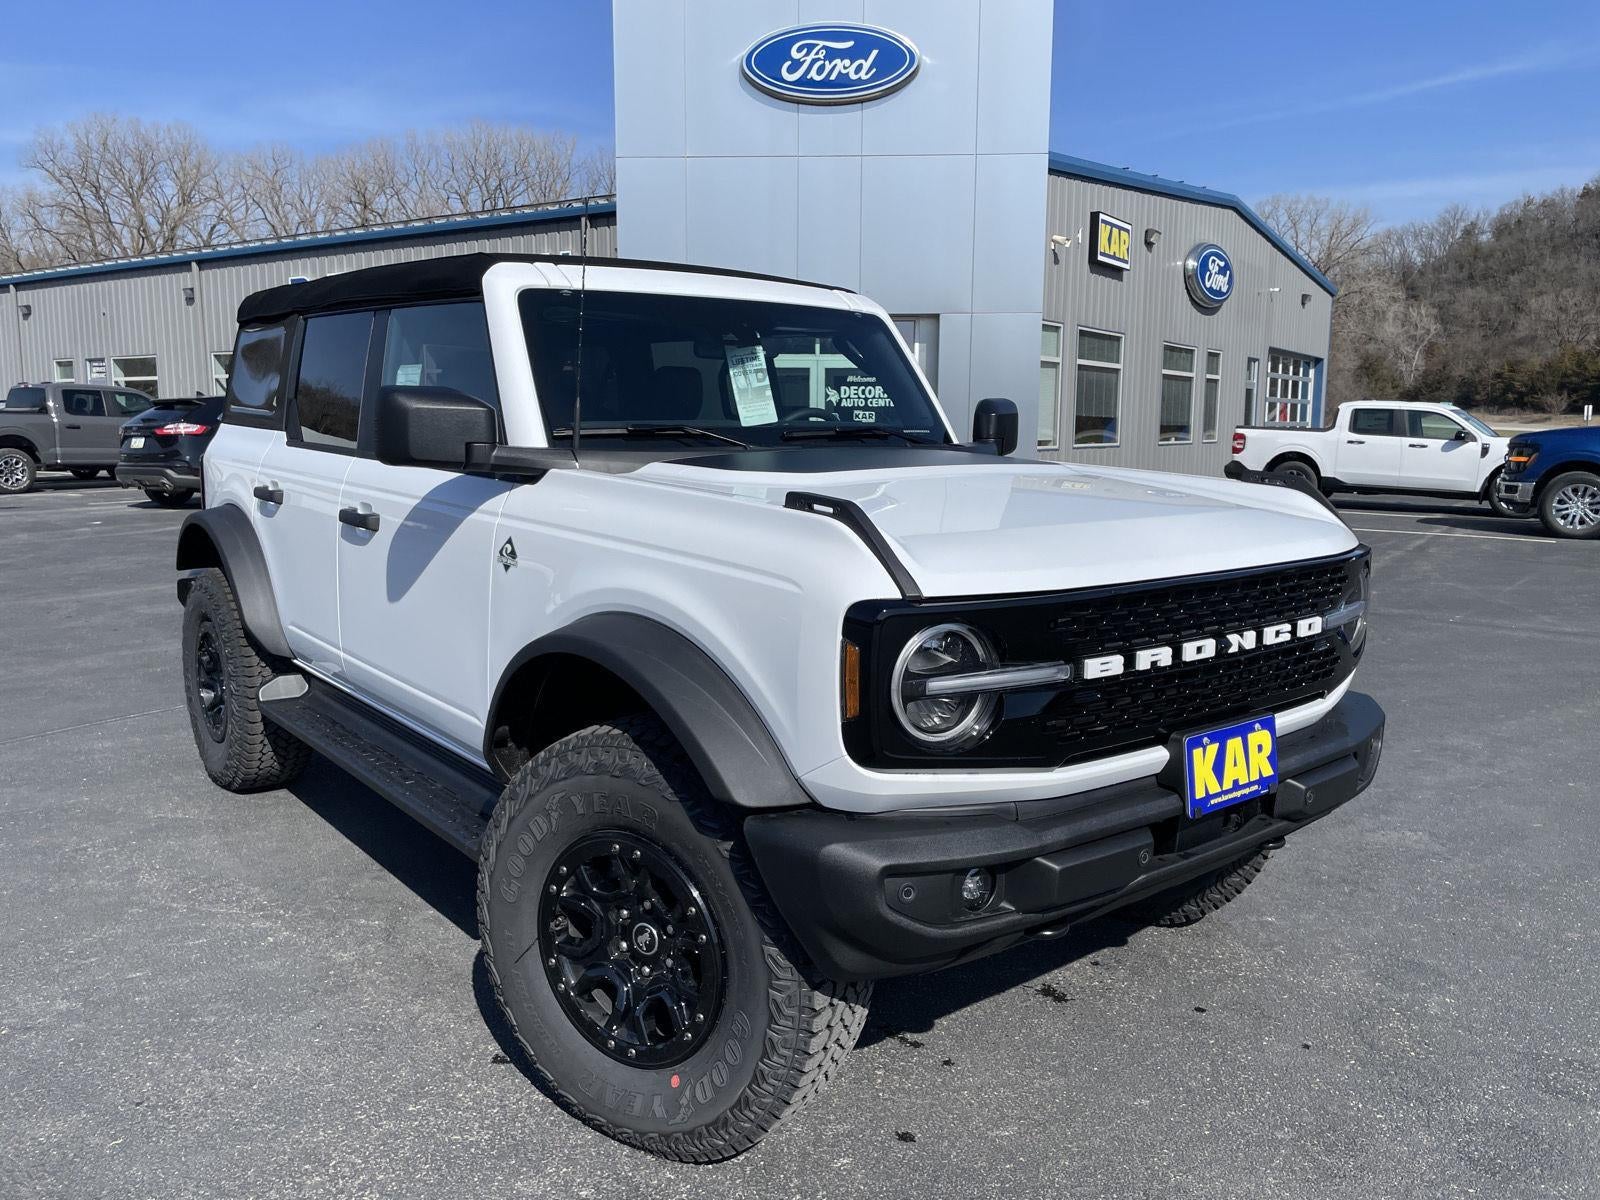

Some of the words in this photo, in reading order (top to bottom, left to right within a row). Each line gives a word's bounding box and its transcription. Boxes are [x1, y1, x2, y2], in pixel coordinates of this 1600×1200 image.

[781, 39, 880, 82] Ford
[1101, 223, 1130, 261] KAR
[1205, 255, 1230, 293] Ford
[731, 355, 762, 366] LIFETIME
[847, 375, 877, 383] Welcome
[840, 398, 865, 407] AUTO
[854, 412, 875, 420] KAR
[1083, 616, 1323, 680] BRONCO
[1192, 729, 1275, 800] KAR
